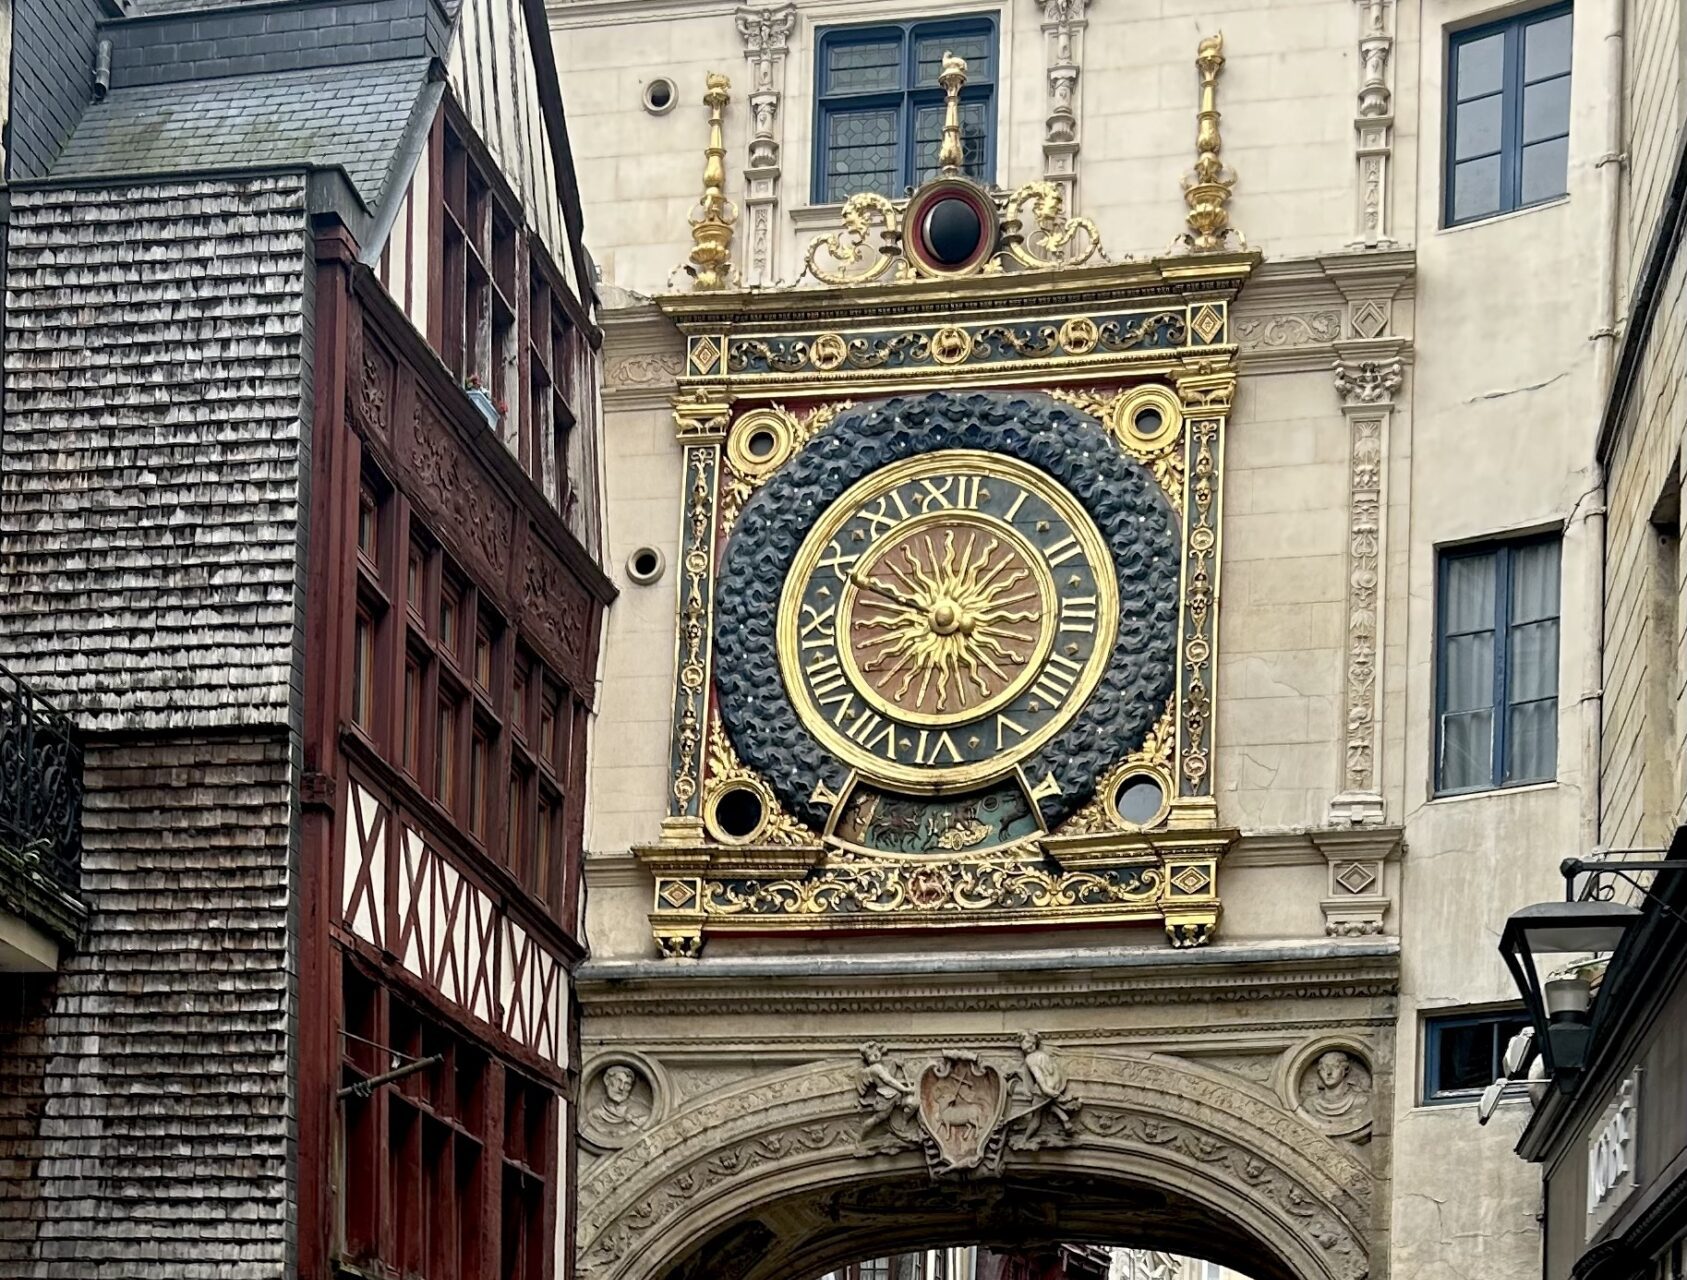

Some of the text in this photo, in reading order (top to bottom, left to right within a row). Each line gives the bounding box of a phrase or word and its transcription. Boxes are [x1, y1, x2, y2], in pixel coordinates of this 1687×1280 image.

[857, 489, 911, 542] XI
[919, 476, 982, 513] XII
[1003, 489, 1030, 523] I
[816, 539, 861, 583] X
[1043, 533, 1084, 569] II
[801, 603, 836, 650] IX
[1060, 594, 1097, 634] III
[806, 654, 855, 727] VIII
[1029, 651, 1084, 710] IIII
[845, 707, 897, 761] VII
[914, 730, 965, 765] VI
[996, 713, 1030, 751] V
